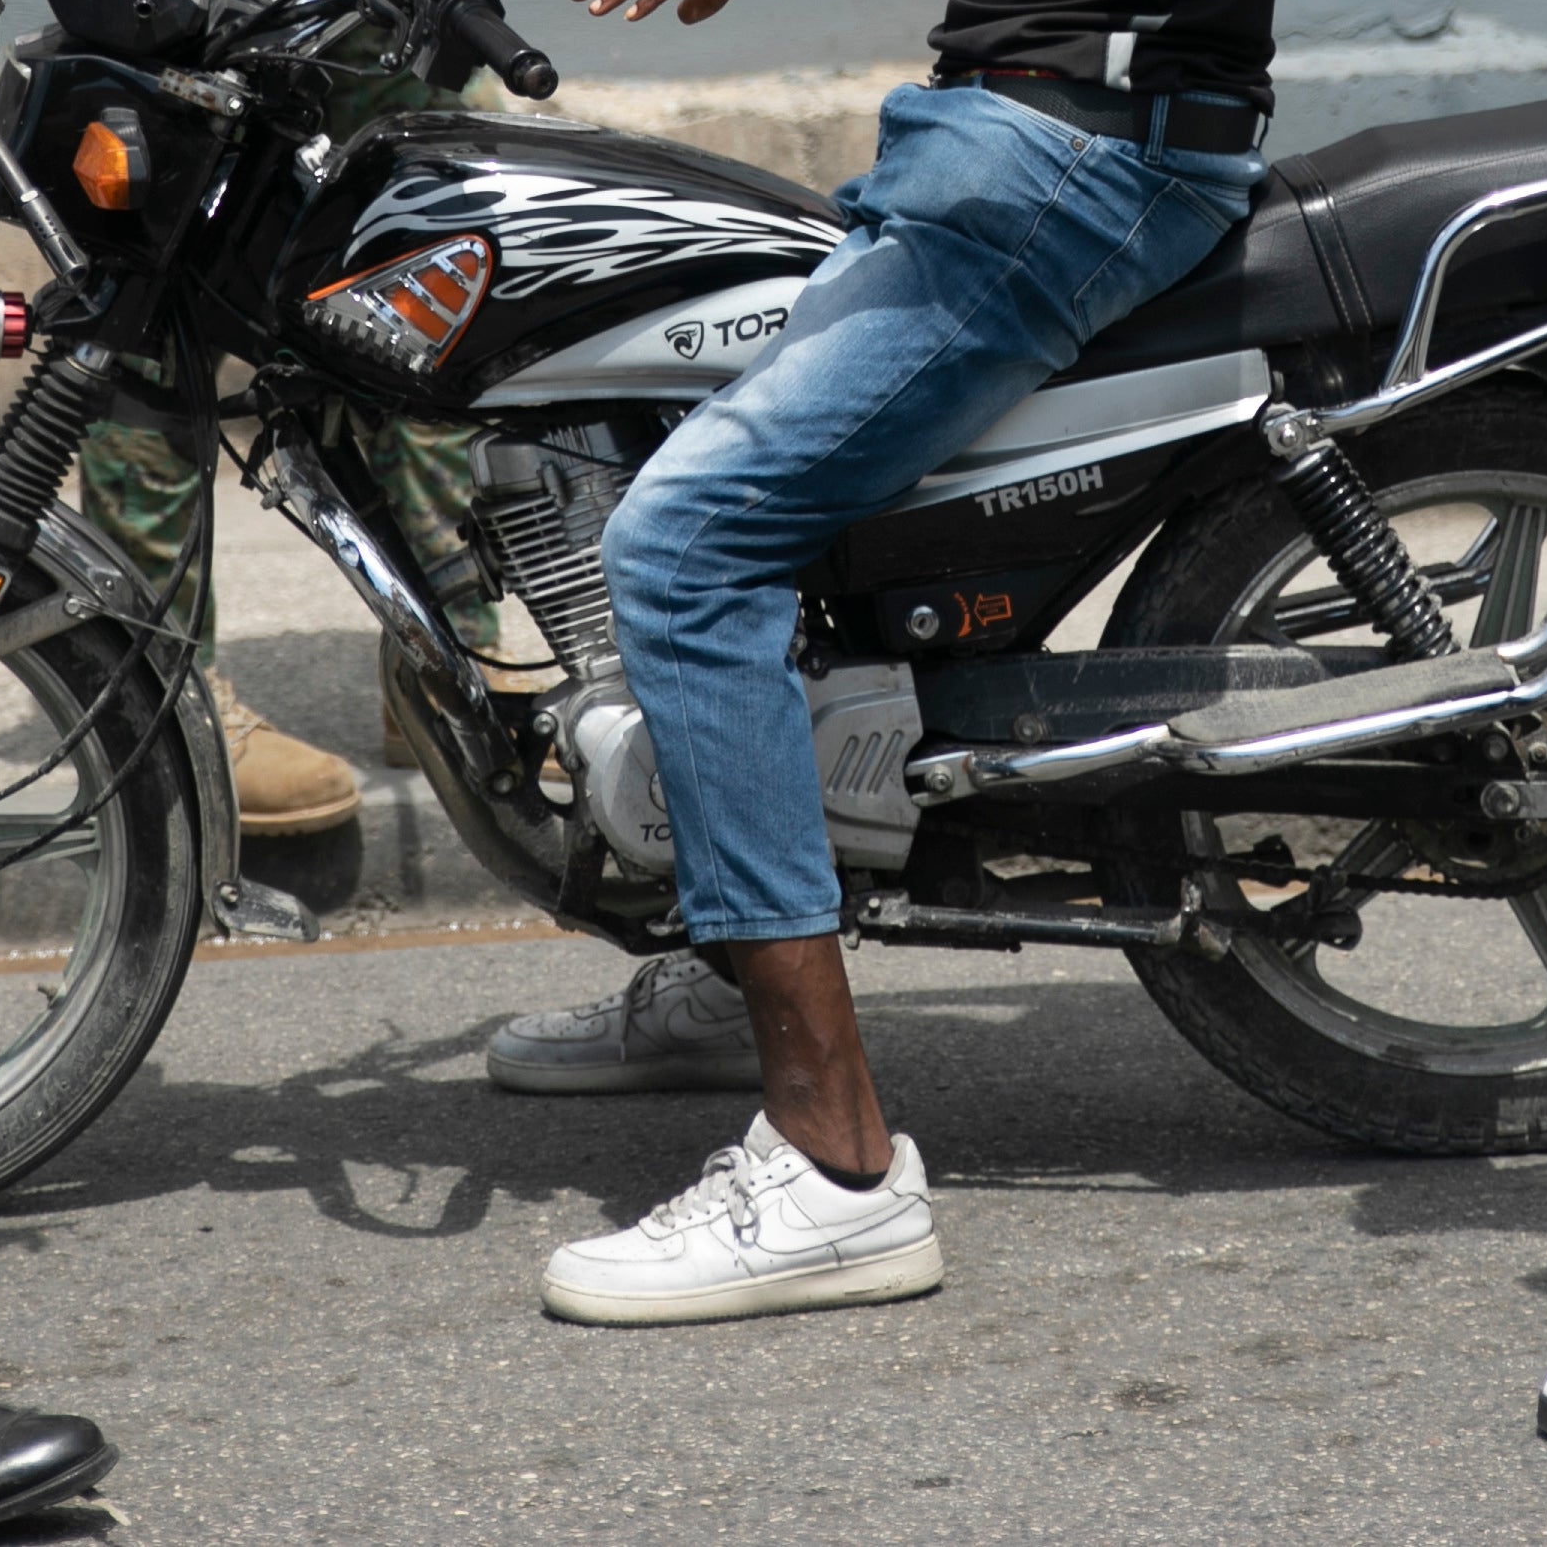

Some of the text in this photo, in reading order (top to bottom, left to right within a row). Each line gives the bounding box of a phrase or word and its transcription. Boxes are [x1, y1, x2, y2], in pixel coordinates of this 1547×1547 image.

[712, 307, 788, 347] TOR
[975, 466, 1103, 518] TR150H
[639, 823, 673, 843] TO
